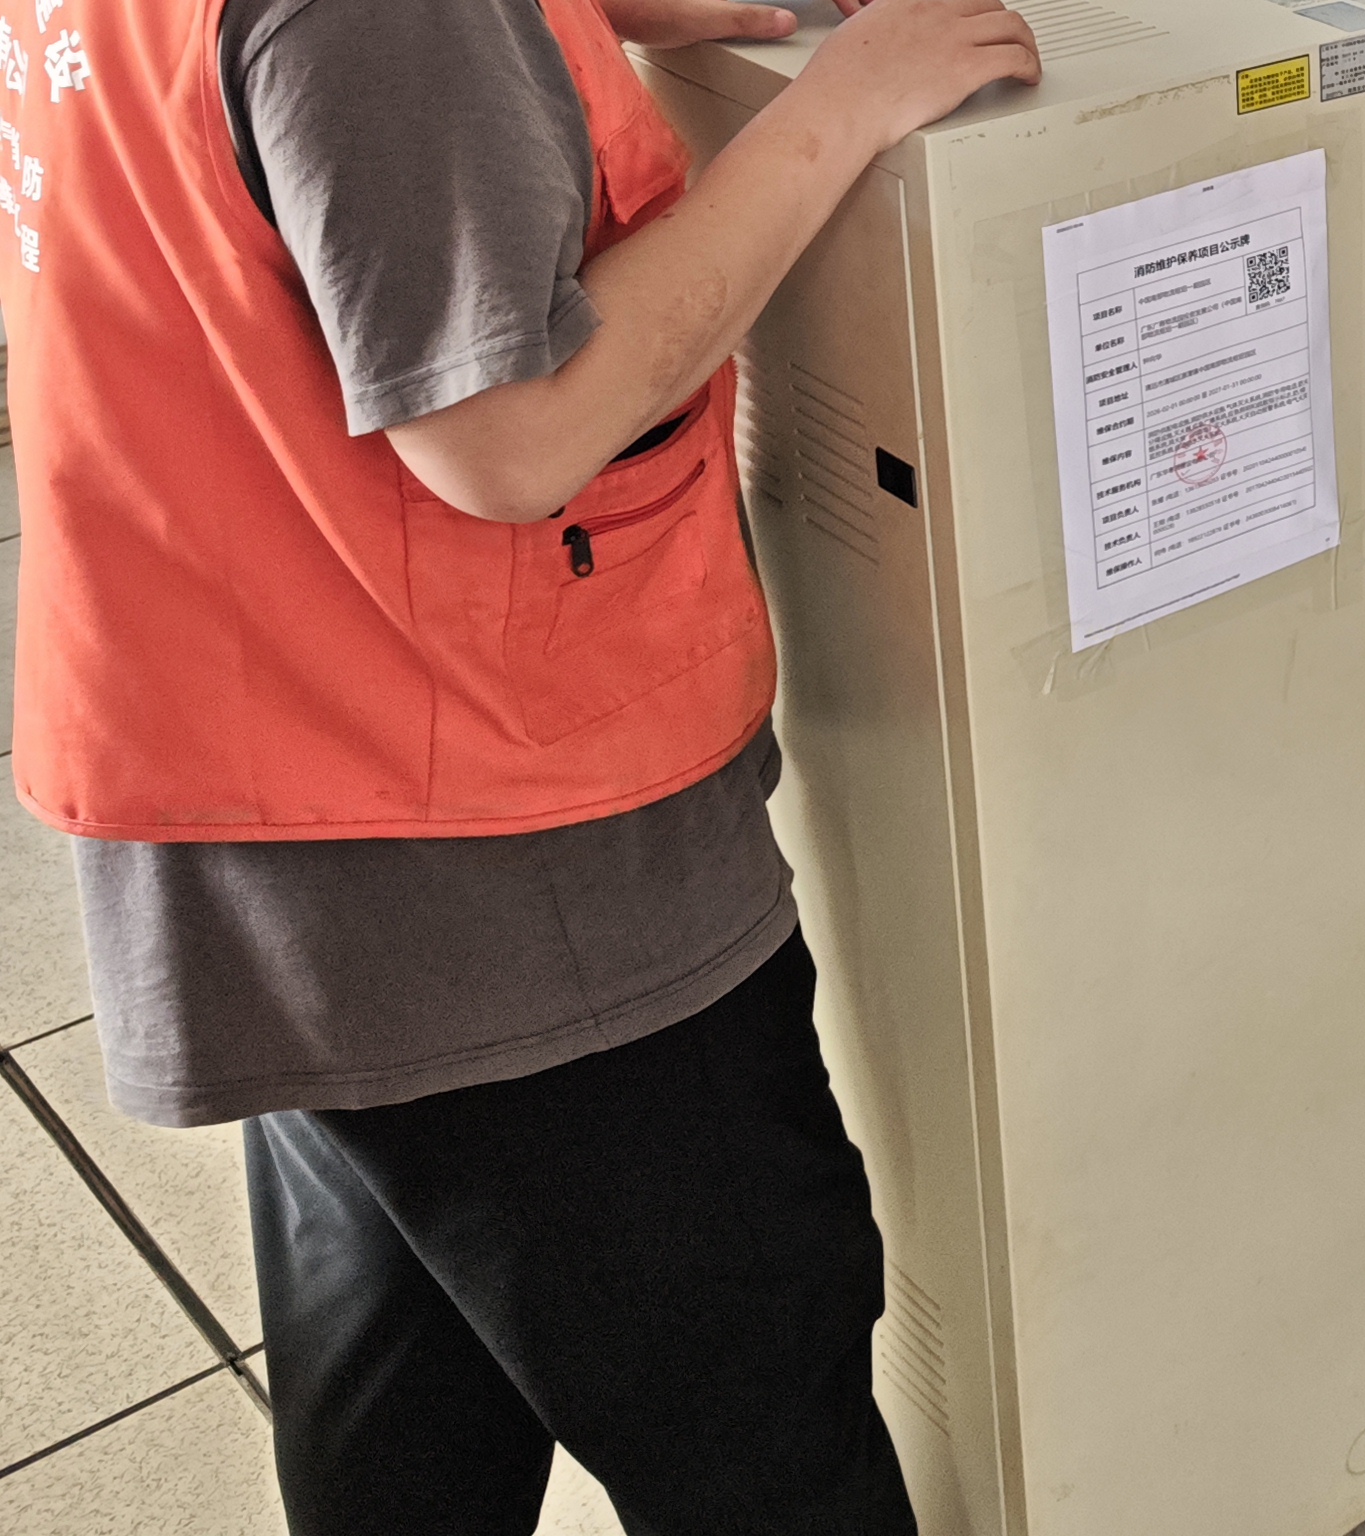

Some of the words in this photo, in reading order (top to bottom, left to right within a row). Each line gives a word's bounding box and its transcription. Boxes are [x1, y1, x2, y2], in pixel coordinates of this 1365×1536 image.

[1133, 232, 1250, 279] 消防维护保养项目公示牌
[1092, 304, 1122, 321] 项目名称
[1094, 335, 1124, 352] 单位名称
[1085, 360, 1137, 385] 消防安全管理人
[1098, 390, 1128, 408] 项目地址
[1096, 416, 1134, 436] 维保合约期
[1101, 448, 1132, 466] 维保内容
[1096, 476, 1141, 501] 技术服务机构
[1102, 503, 1138, 525] 项目负责人
[1104, 529, 1140, 551] 技术负责人
[1105, 555, 1142, 577] 维保操作人
